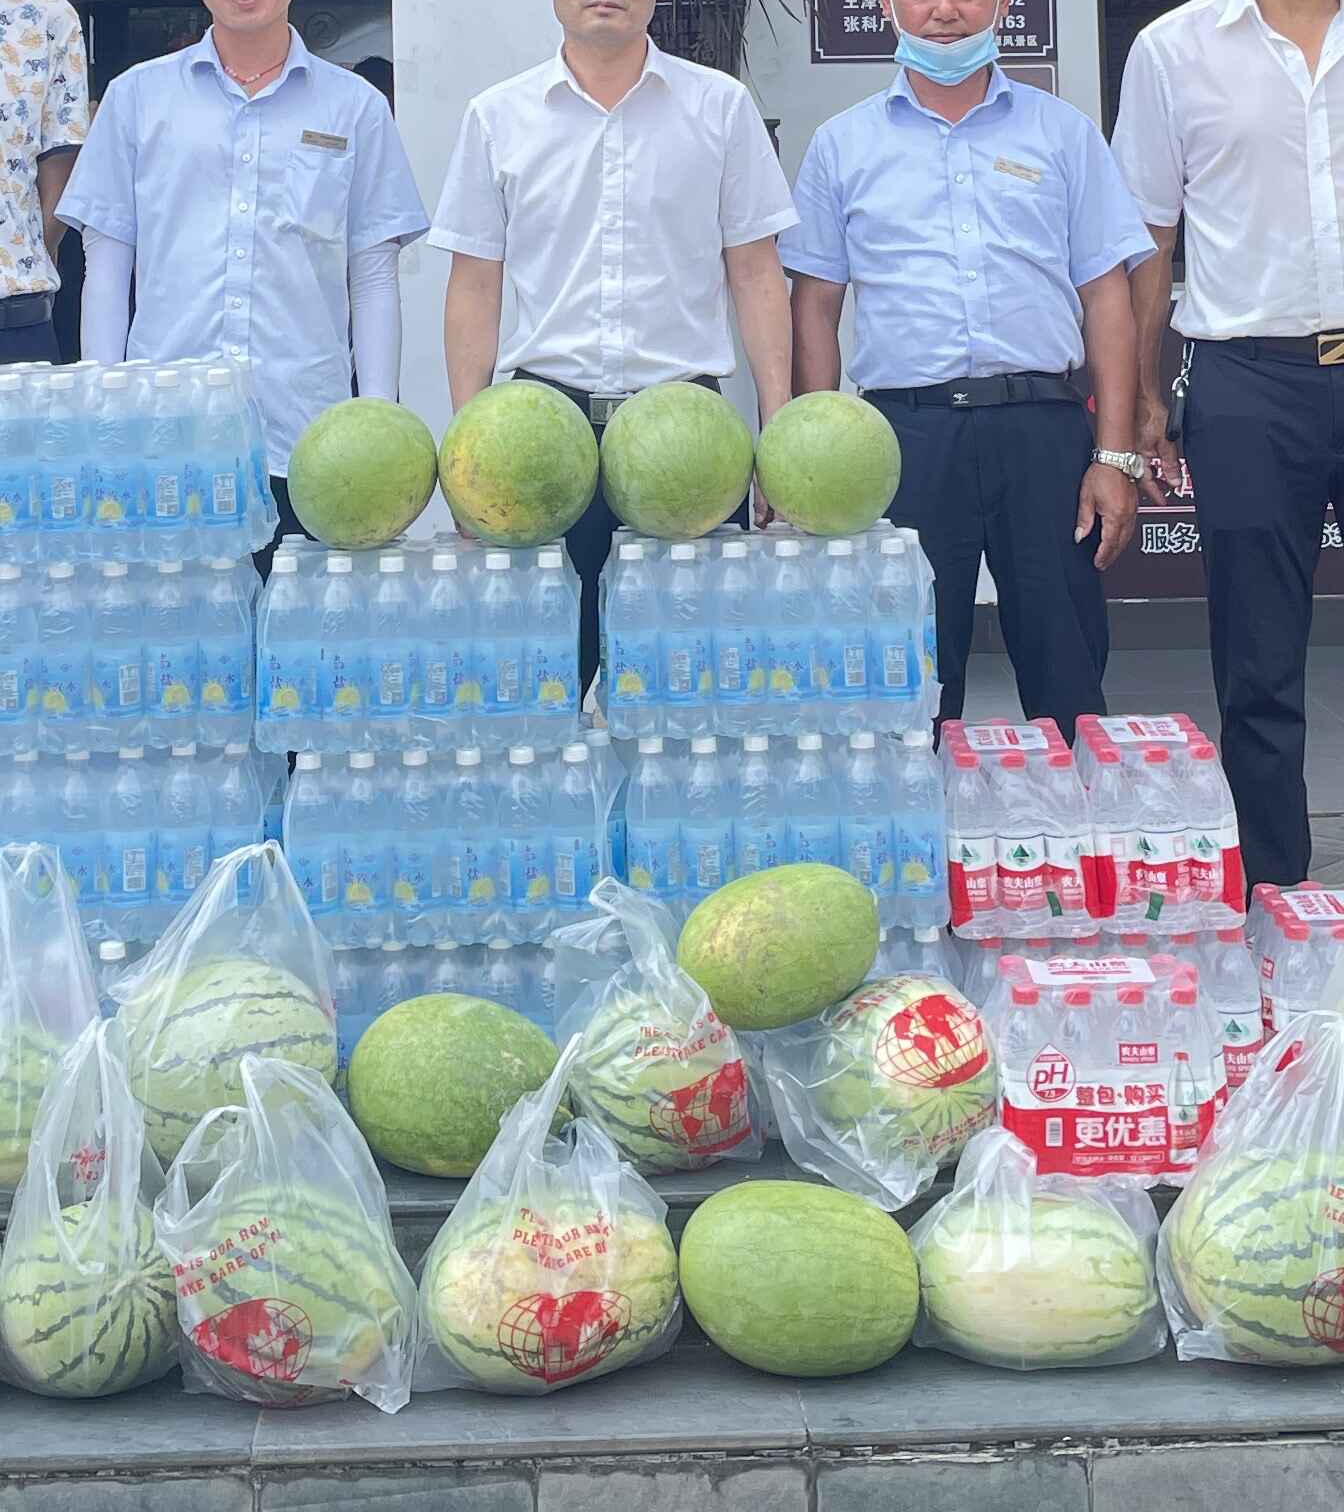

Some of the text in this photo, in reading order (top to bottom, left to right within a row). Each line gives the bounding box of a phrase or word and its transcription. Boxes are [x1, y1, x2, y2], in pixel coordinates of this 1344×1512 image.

[1034, 1063, 1069, 1092] pH
[1074, 1115, 1167, 1149] 更优惠
[209, 1237, 234, 1261] OUR
[209, 1255, 247, 1284] CARE
